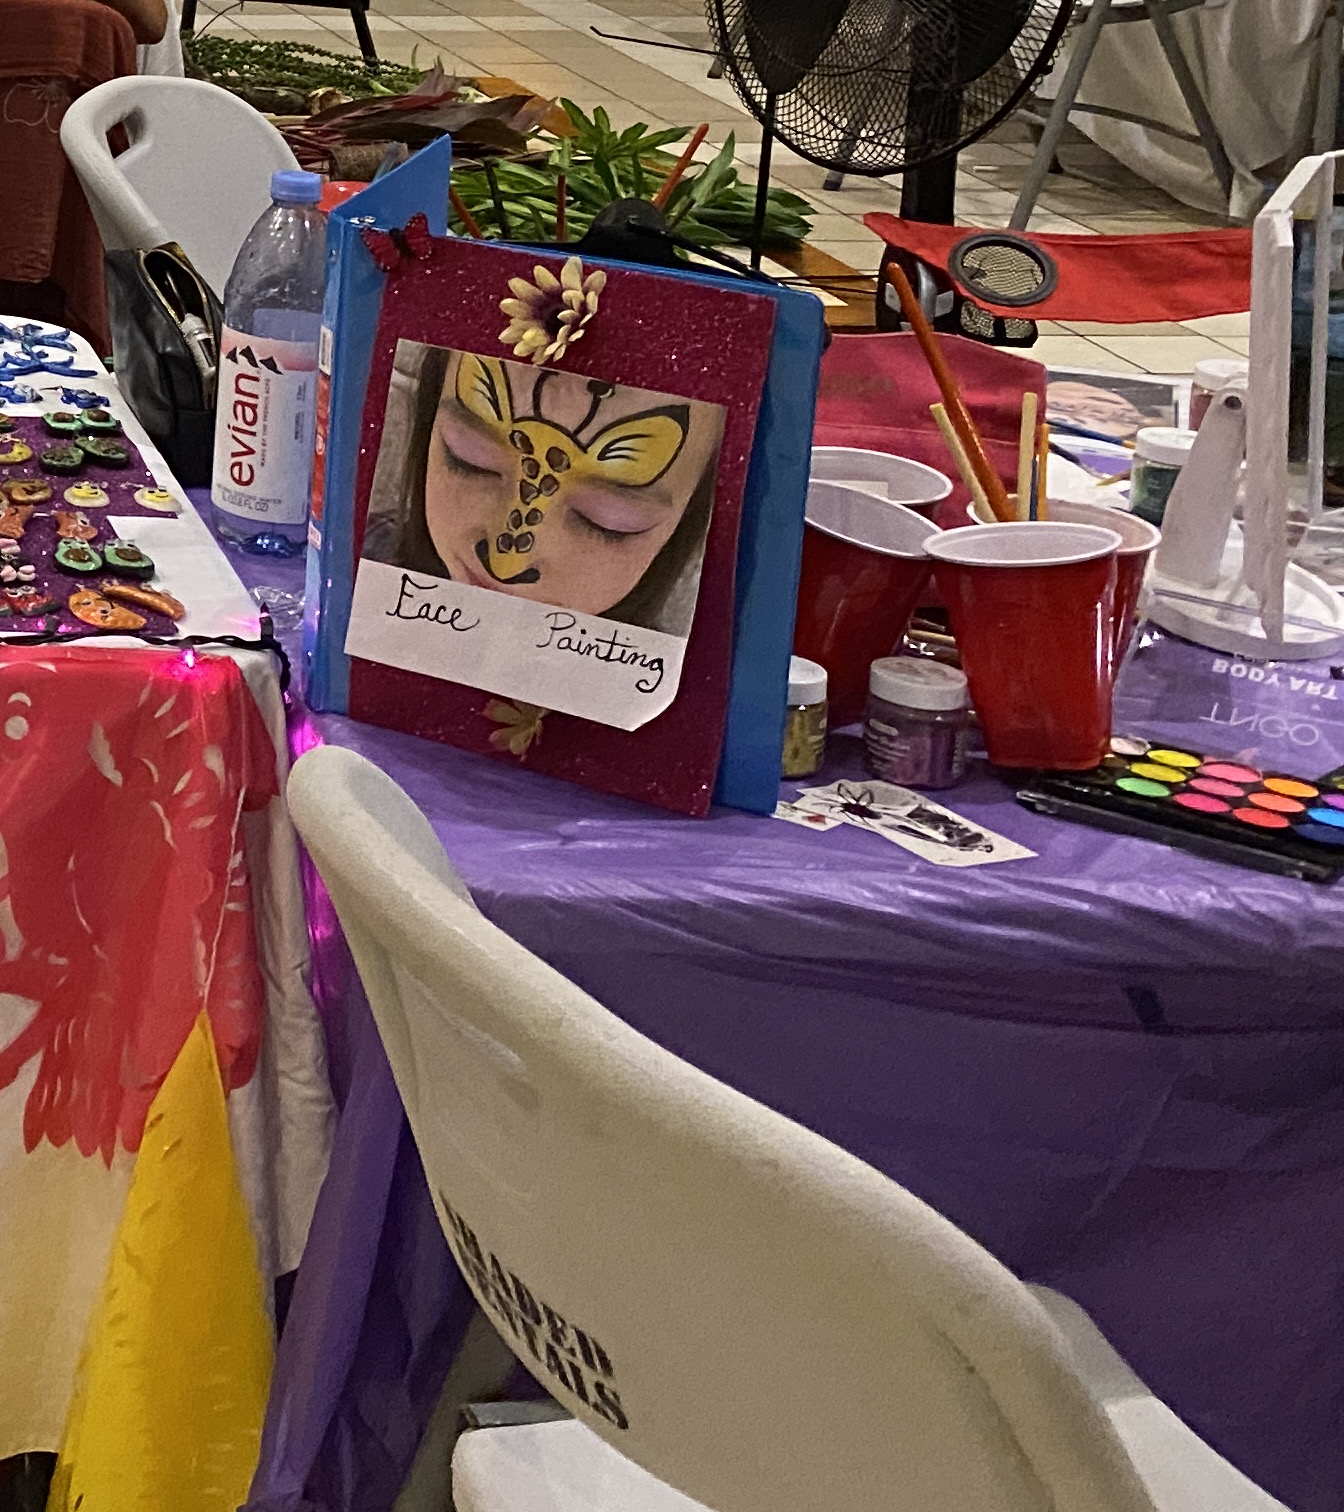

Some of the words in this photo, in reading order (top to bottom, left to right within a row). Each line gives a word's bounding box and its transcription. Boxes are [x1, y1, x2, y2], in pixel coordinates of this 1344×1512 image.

[227, 372, 261, 487] evian
[385, 573, 480, 631] Face
[535, 611, 665, 694] Painting
